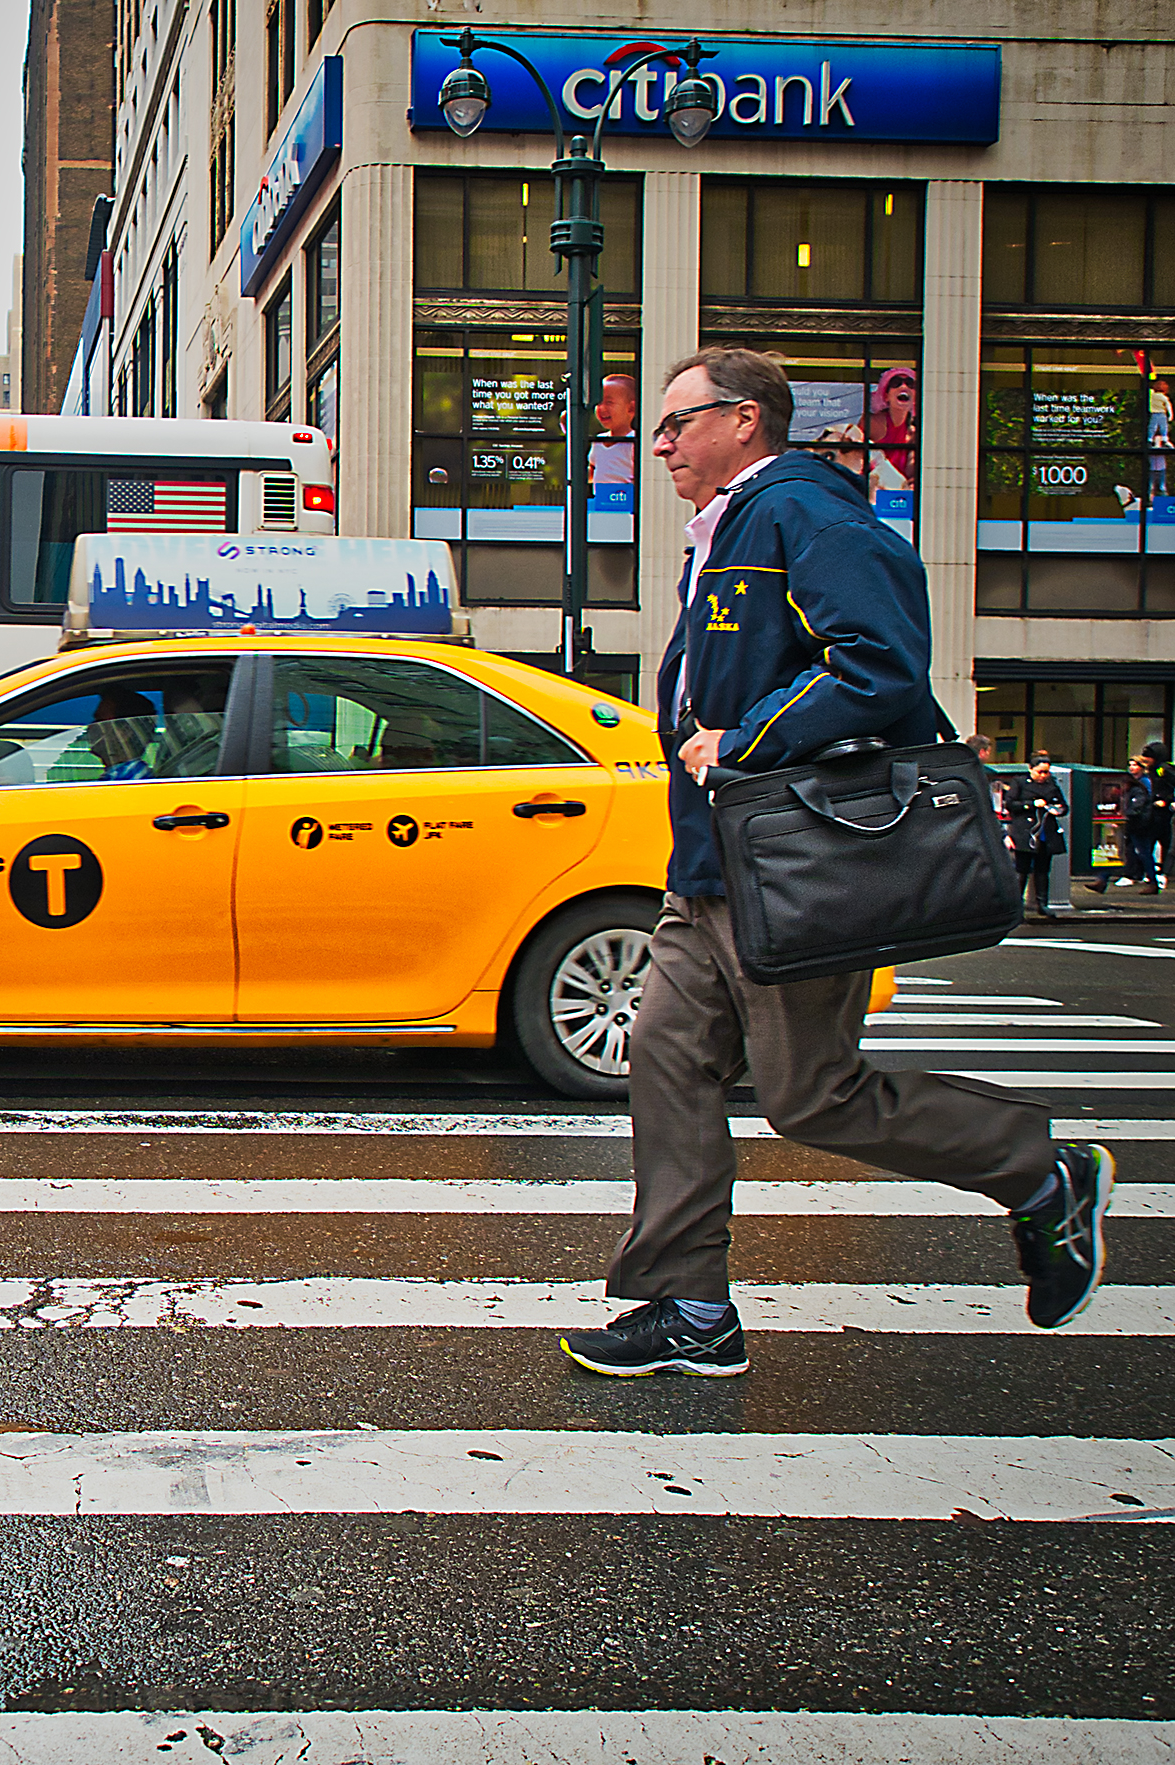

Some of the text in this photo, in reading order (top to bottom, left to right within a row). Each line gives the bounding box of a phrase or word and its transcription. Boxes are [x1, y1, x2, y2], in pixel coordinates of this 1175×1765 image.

[472, 379, 498, 388] When
[520, 380, 535, 388] the
[537, 380, 554, 389] last
[472, 390, 567, 400] time you got more of
[812, 389, 829, 397] you
[1033, 393, 1095, 402] When was the
[472, 400, 554, 410] what you wanted?
[823, 398, 841, 407] that
[819, 408, 850, 418] vision?
[1033, 404, 1115, 413] last time teamwork
[1067, 416, 1080, 424] for
[1083, 415, 1104, 425] you?
[472, 455, 545, 470] 1.35% 0.41%
[609, 491, 627, 502] citi
[889, 498, 907, 508] citi
[246, 546, 315, 556] STRONG
[329, 822, 373, 831] METERED
[29, 853, 82, 916] T
